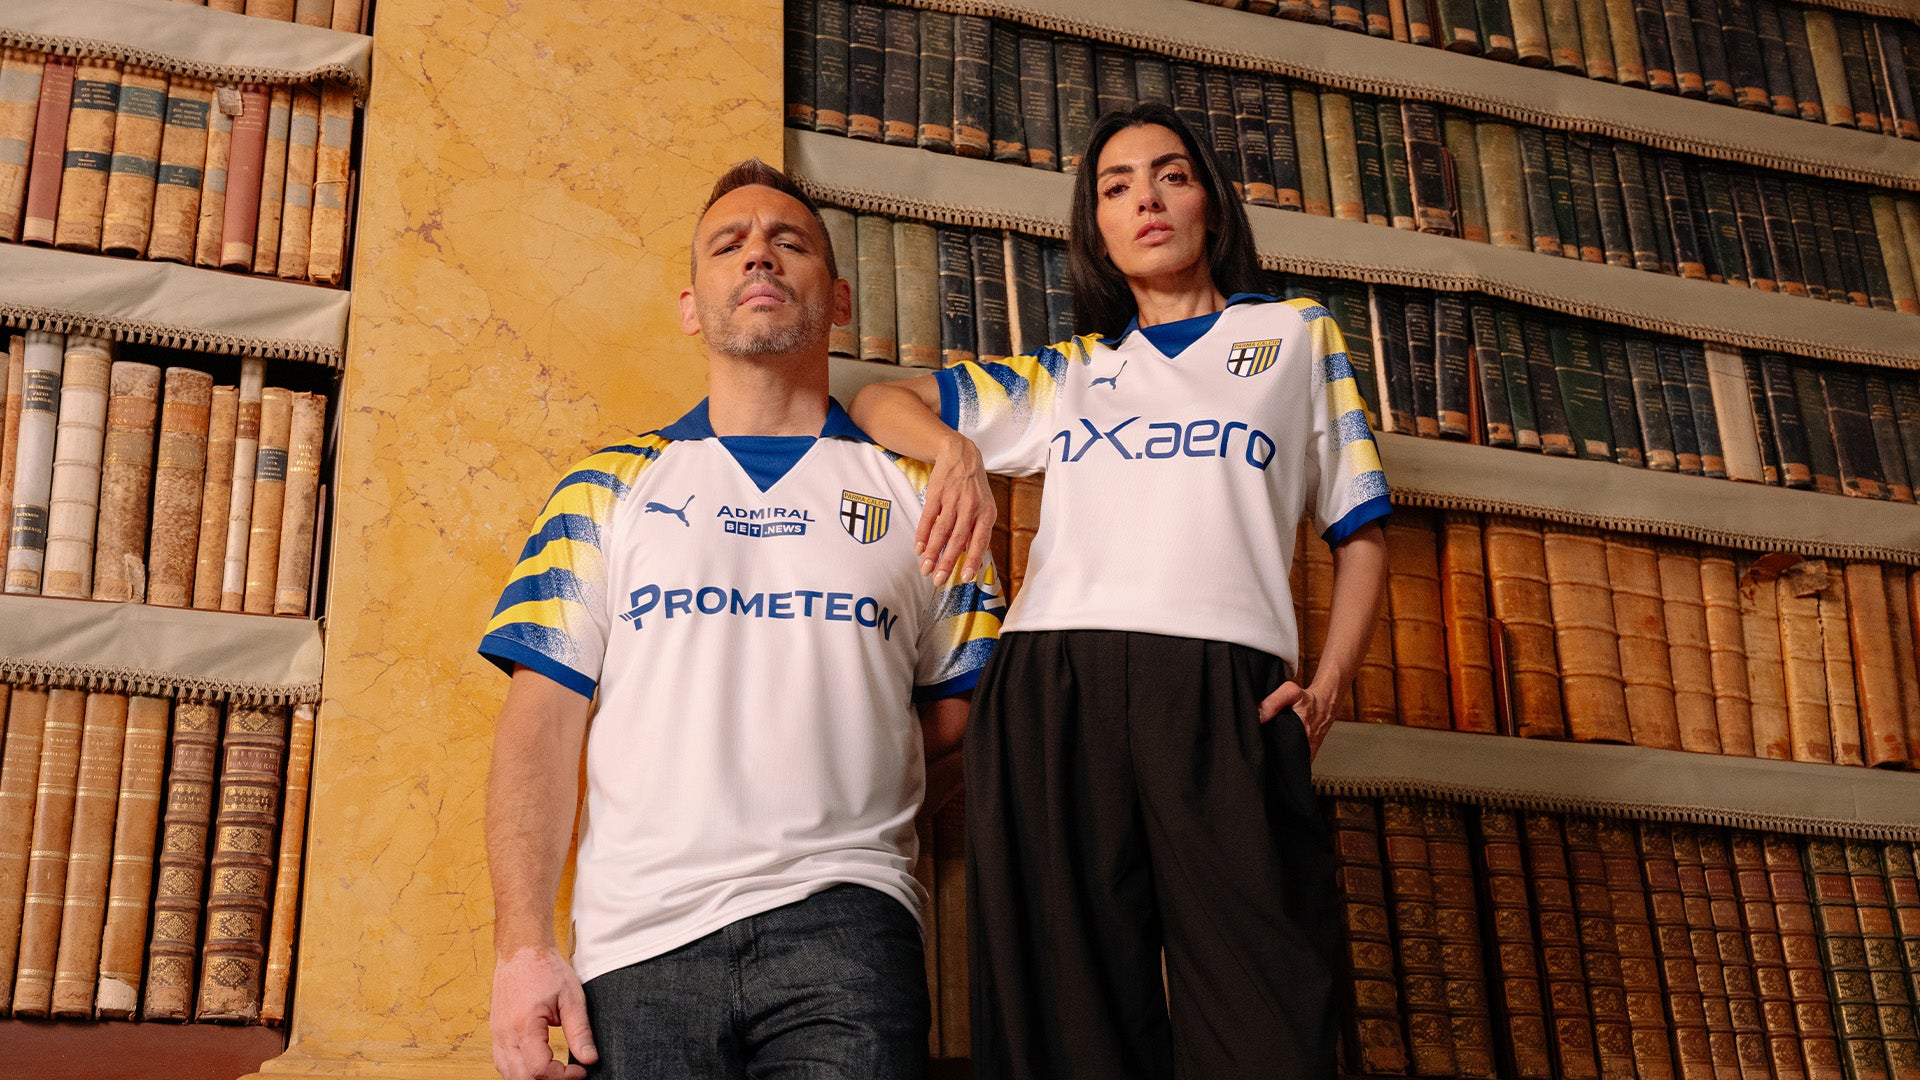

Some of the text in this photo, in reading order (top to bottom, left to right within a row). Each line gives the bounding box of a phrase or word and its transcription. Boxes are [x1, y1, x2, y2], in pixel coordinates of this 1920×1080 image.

[844, 492, 889, 508] PARMA CALCIO
[717, 505, 816, 522] ADMIRAL
[619, 584, 897, 641] PROMETEON
